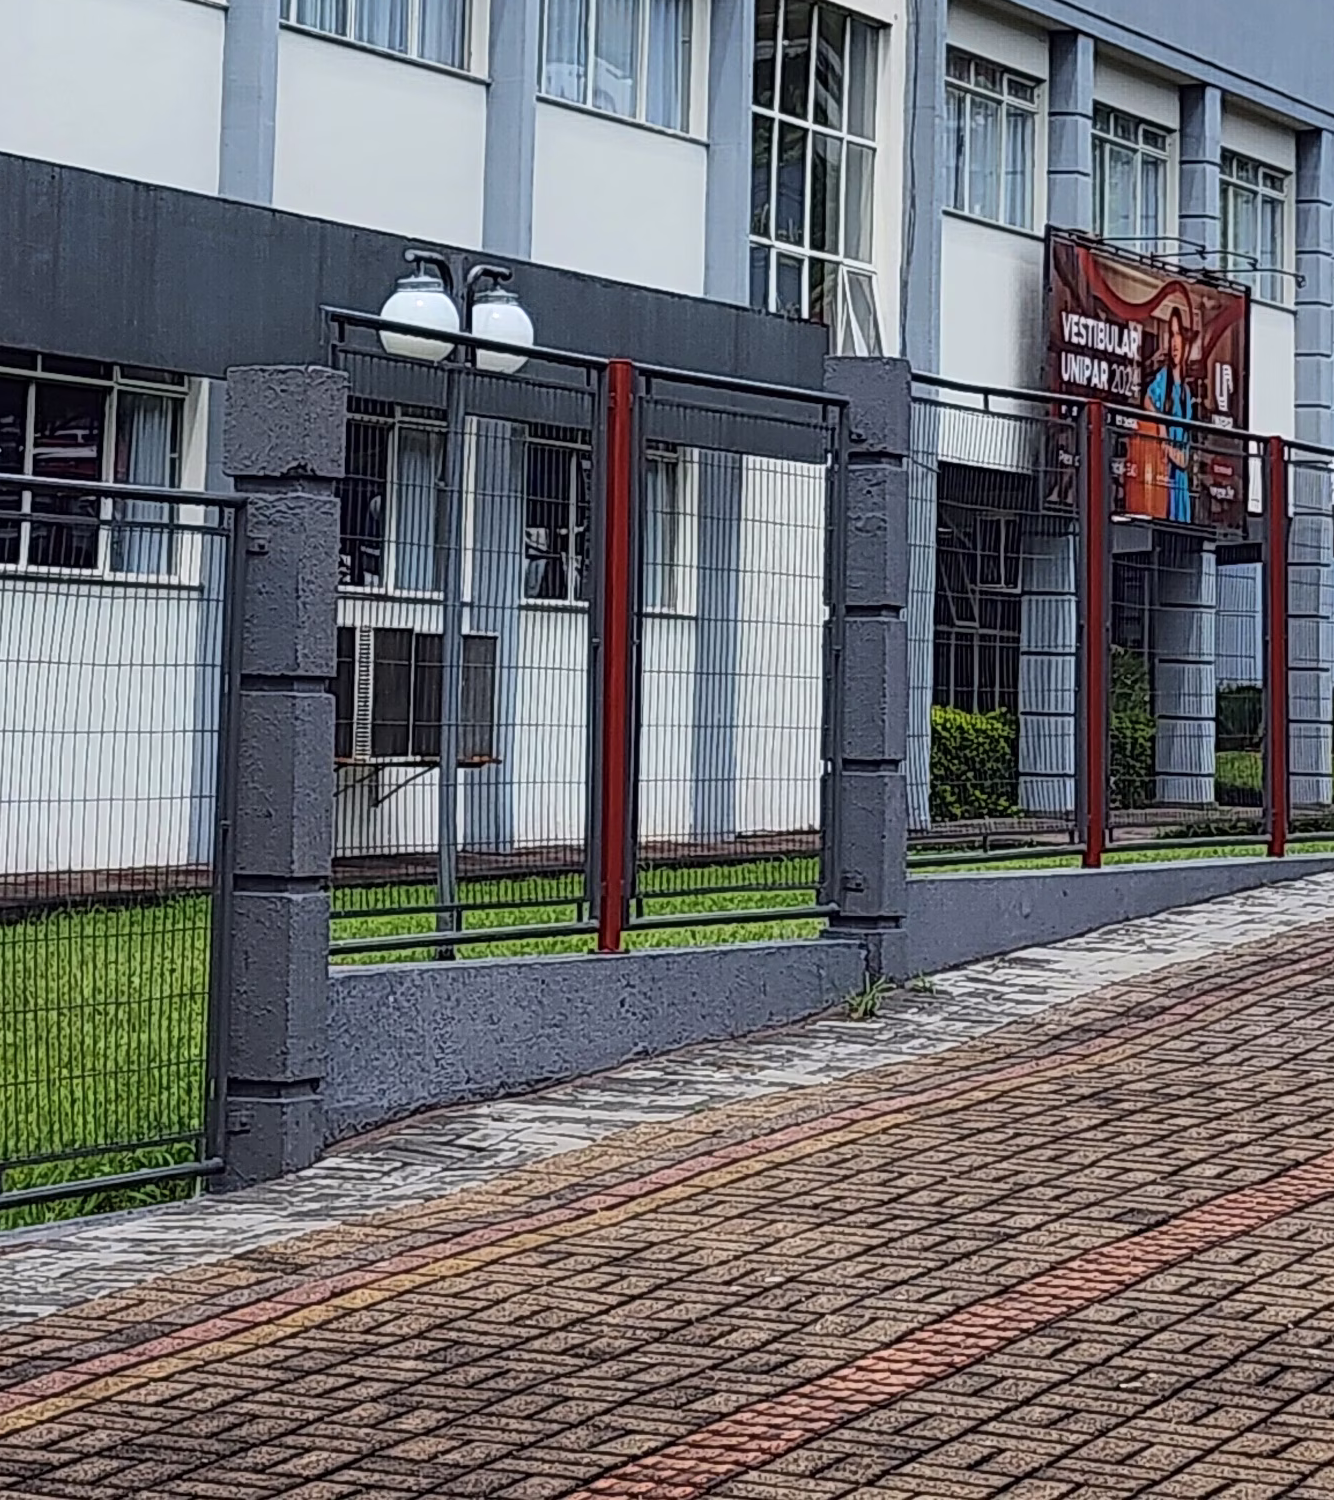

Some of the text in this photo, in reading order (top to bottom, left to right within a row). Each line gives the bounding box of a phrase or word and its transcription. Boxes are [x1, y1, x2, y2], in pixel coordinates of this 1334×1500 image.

[1061, 311, 1141, 362] VESTIBULAR
[1061, 351, 1142, 398] UNIPAR 2024
